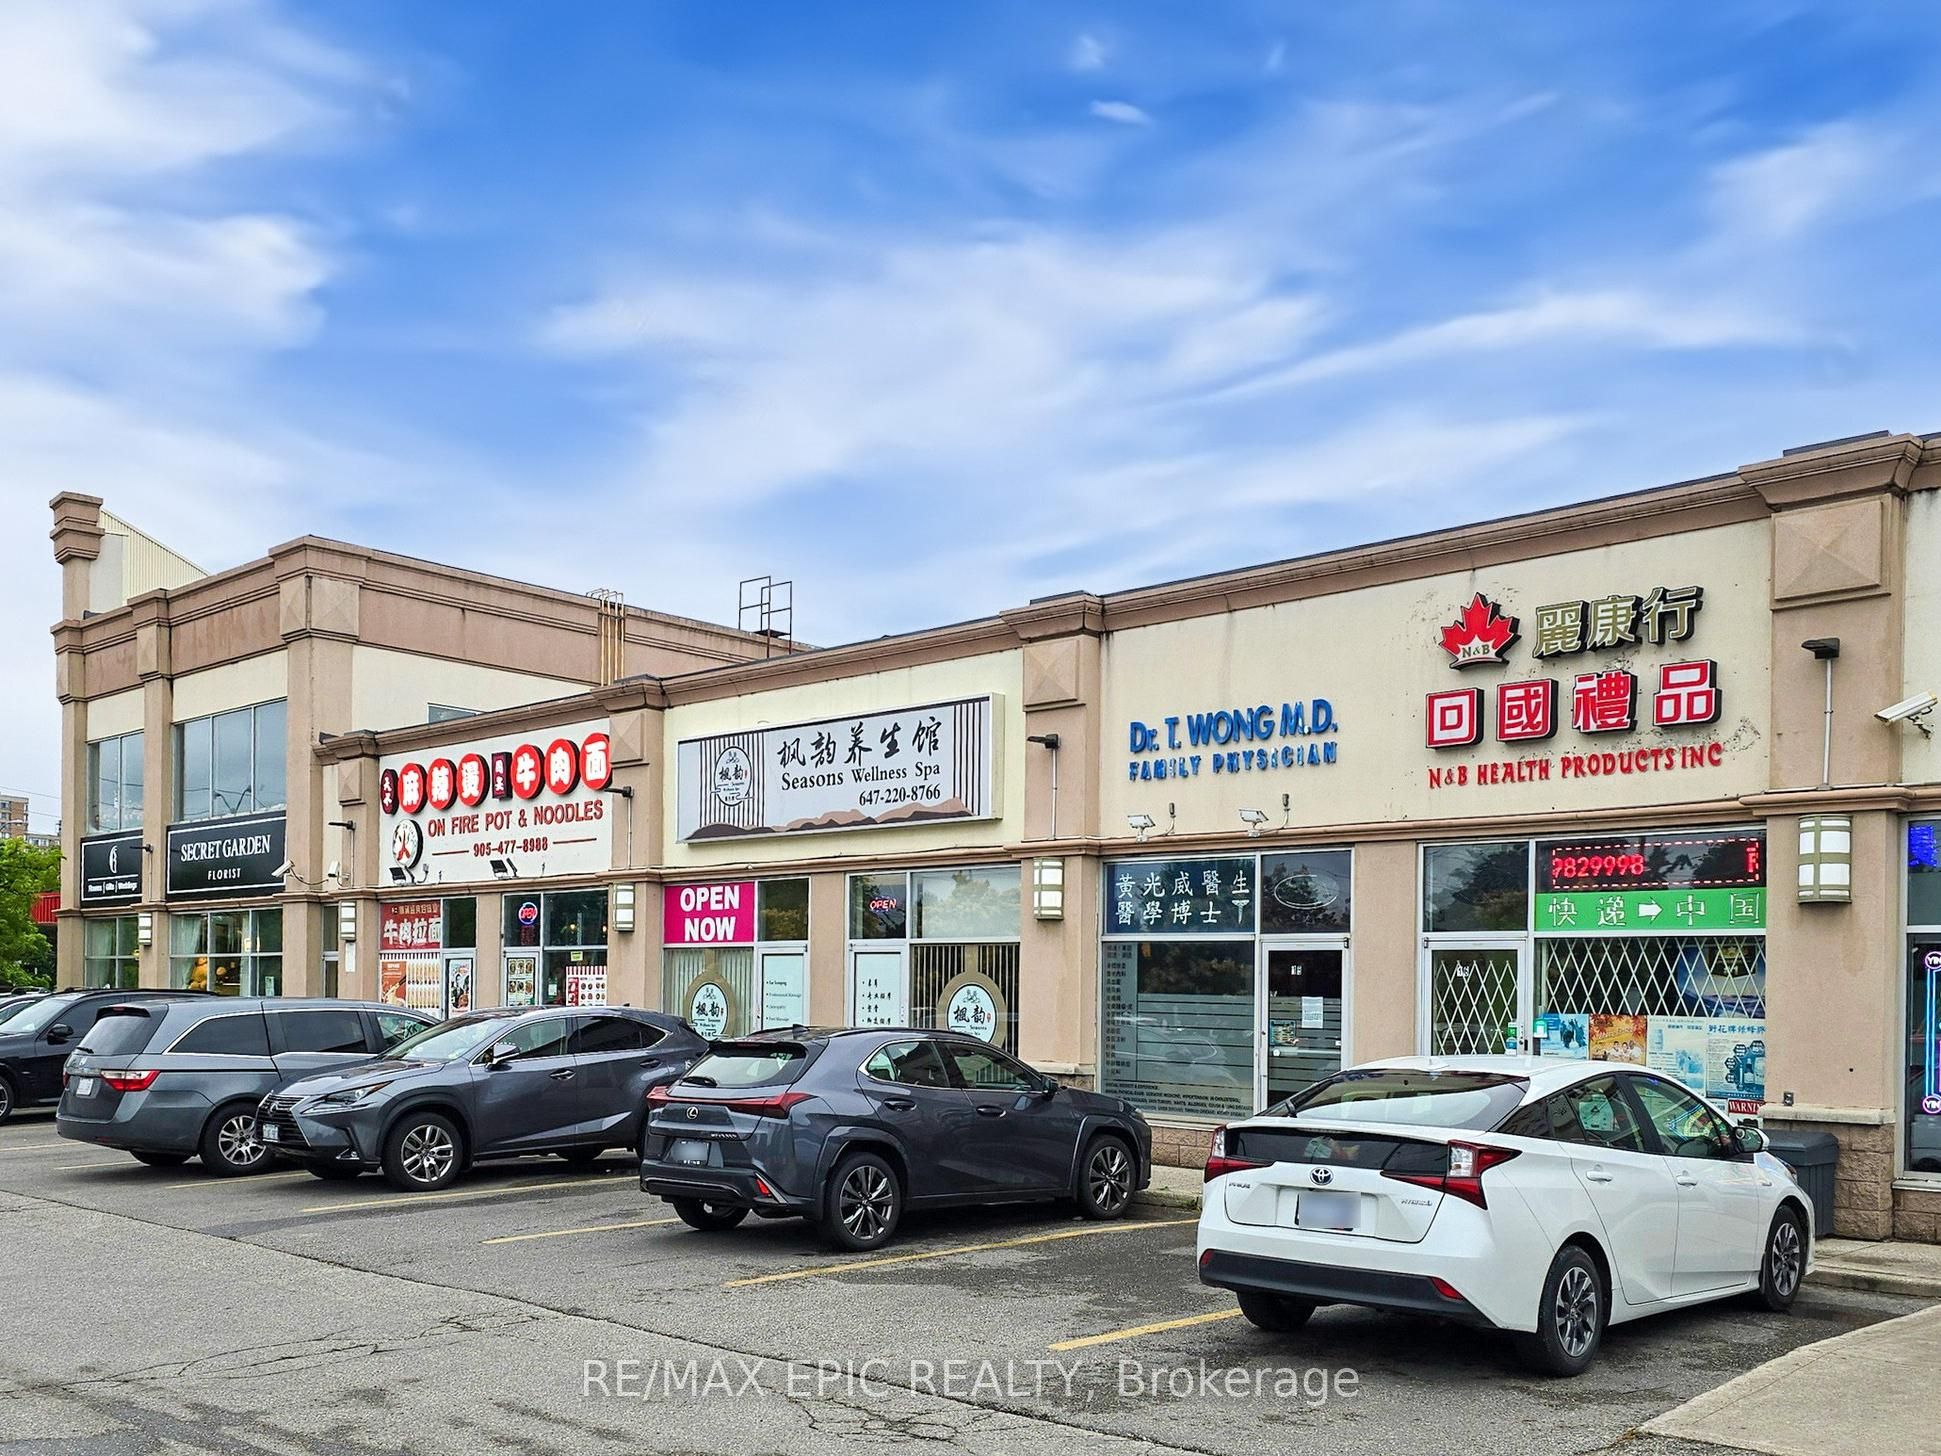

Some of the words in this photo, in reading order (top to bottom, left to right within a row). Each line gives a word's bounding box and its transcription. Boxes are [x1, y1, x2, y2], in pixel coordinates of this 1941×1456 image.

[1533, 586, 1701, 659] 麗康行
[1462, 643, 1490, 658] N&B
[1426, 659, 1717, 748] 回國禮品
[1129, 721, 1160, 753] Dr.
[1164, 716, 1182, 749] T.
[1187, 704, 1275, 746] WONG
[1279, 698, 1338, 738] M.D.
[1128, 754, 1201, 781] FAMILY
[1213, 741, 1338, 774] PHYSICIAN
[1429, 766, 1468, 788] N&B
[1477, 759, 1550, 786] HEALTH
[1561, 748, 1674, 778] PRODUCTS
[1681, 742, 1723, 768] INC
[781, 769, 844, 791] Seasons
[852, 764, 907, 784] Wellness
[915, 762, 941, 781] Spa
[859, 783, 941, 806] 647-220-8766
[428, 818, 446, 837] ON
[451, 813, 479, 834] FIRE
[485, 811, 512, 831] POT
[518, 809, 528, 827] &
[534, 800, 604, 826] NOODLES
[180, 840, 222, 863] SECRET
[222, 834, 271, 858] GARDEN
[207, 867, 241, 881] FLORIST
[680, 885, 739, 912] OPEN
[870, 898, 896, 910] OPEN
[1115, 900, 1222, 925] 醫學博士
[684, 916, 736, 943] NOW
